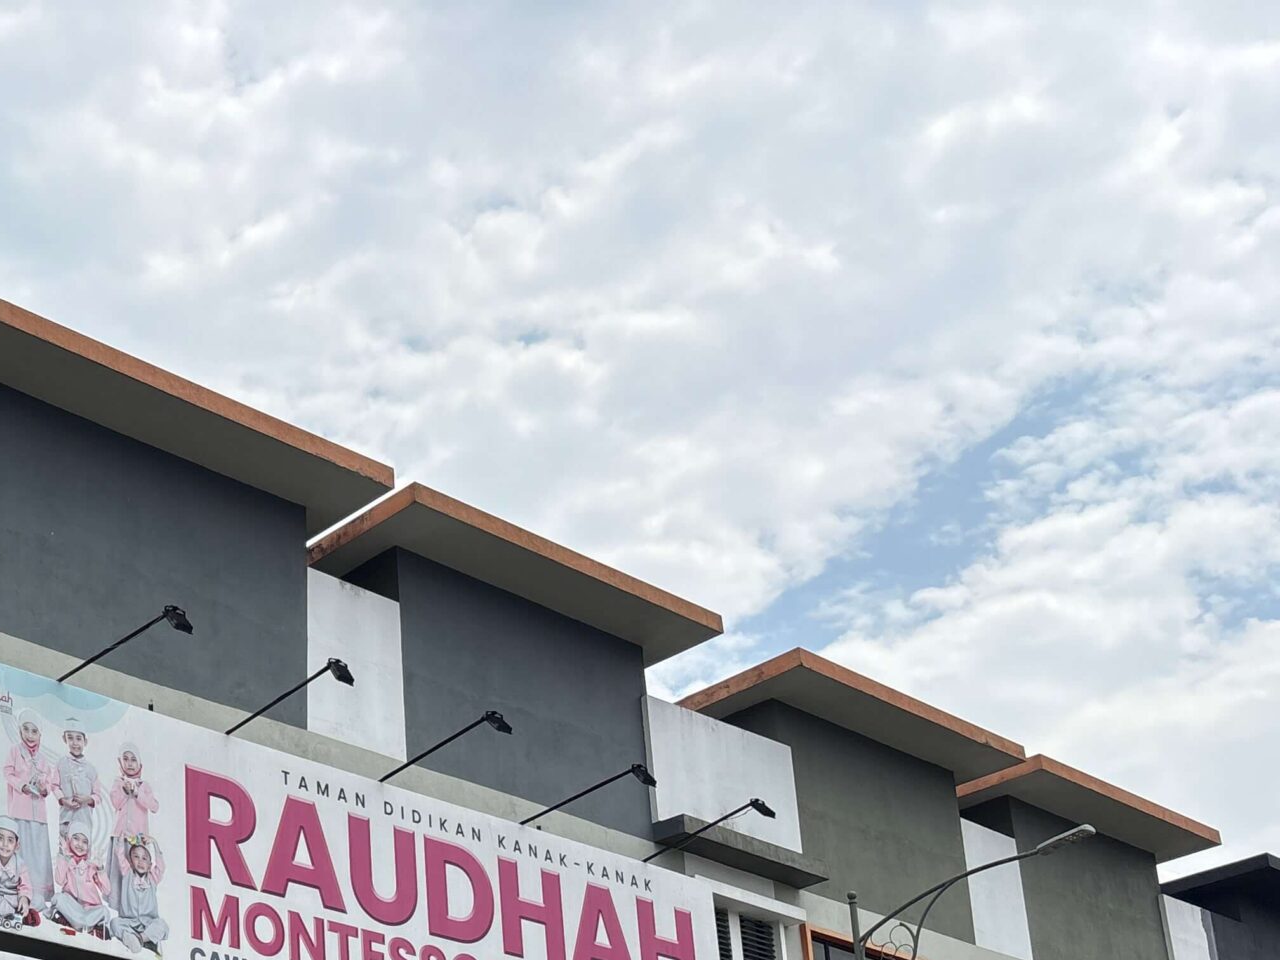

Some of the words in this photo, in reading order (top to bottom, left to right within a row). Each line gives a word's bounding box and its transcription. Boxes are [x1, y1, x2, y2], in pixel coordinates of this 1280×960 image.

[281, 770, 366, 808] TAMAN
[384, 801, 482, 842] DIDIKAN
[497, 834, 653, 893] KANAK-KANAK
